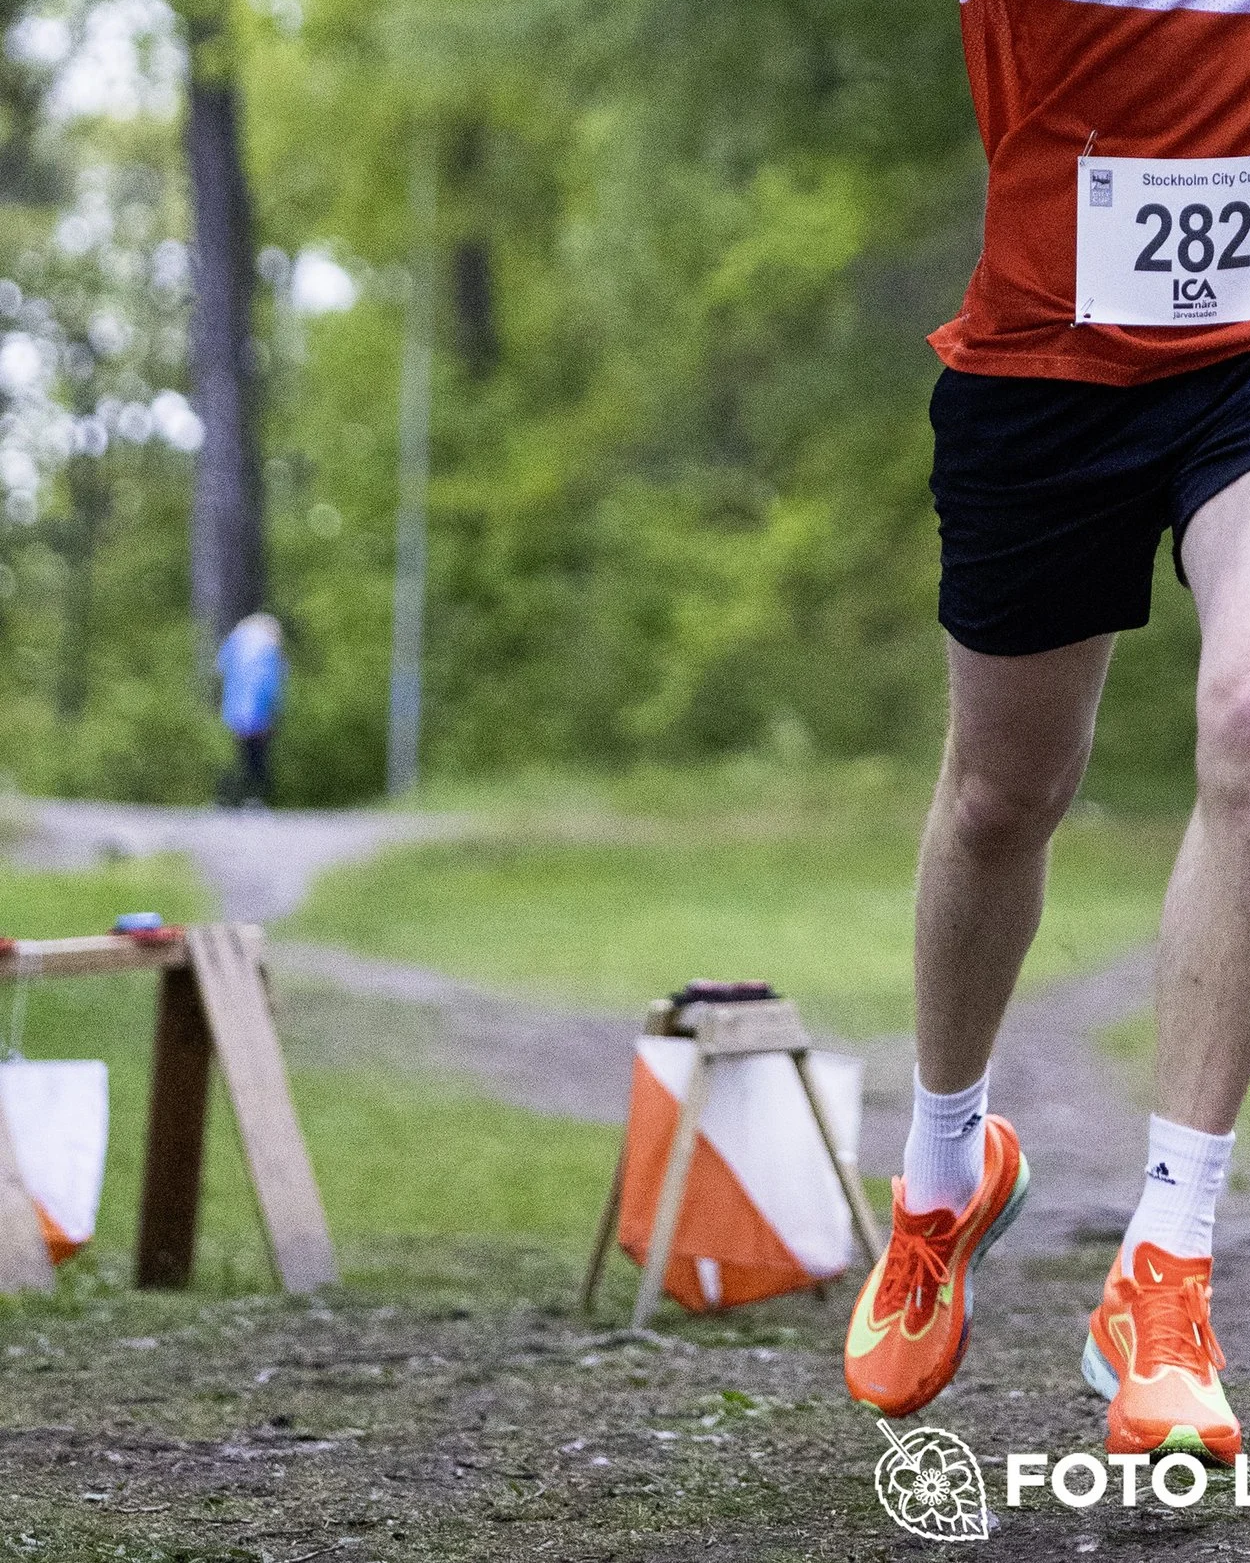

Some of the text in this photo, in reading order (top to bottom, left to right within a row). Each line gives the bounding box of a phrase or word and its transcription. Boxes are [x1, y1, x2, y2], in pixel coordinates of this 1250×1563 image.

[1142, 173, 1208, 186] Stockholm
[1212, 172, 1236, 187] City
[1173, 278, 1217, 301] ICA
[1194, 300, 1218, 309] nära
